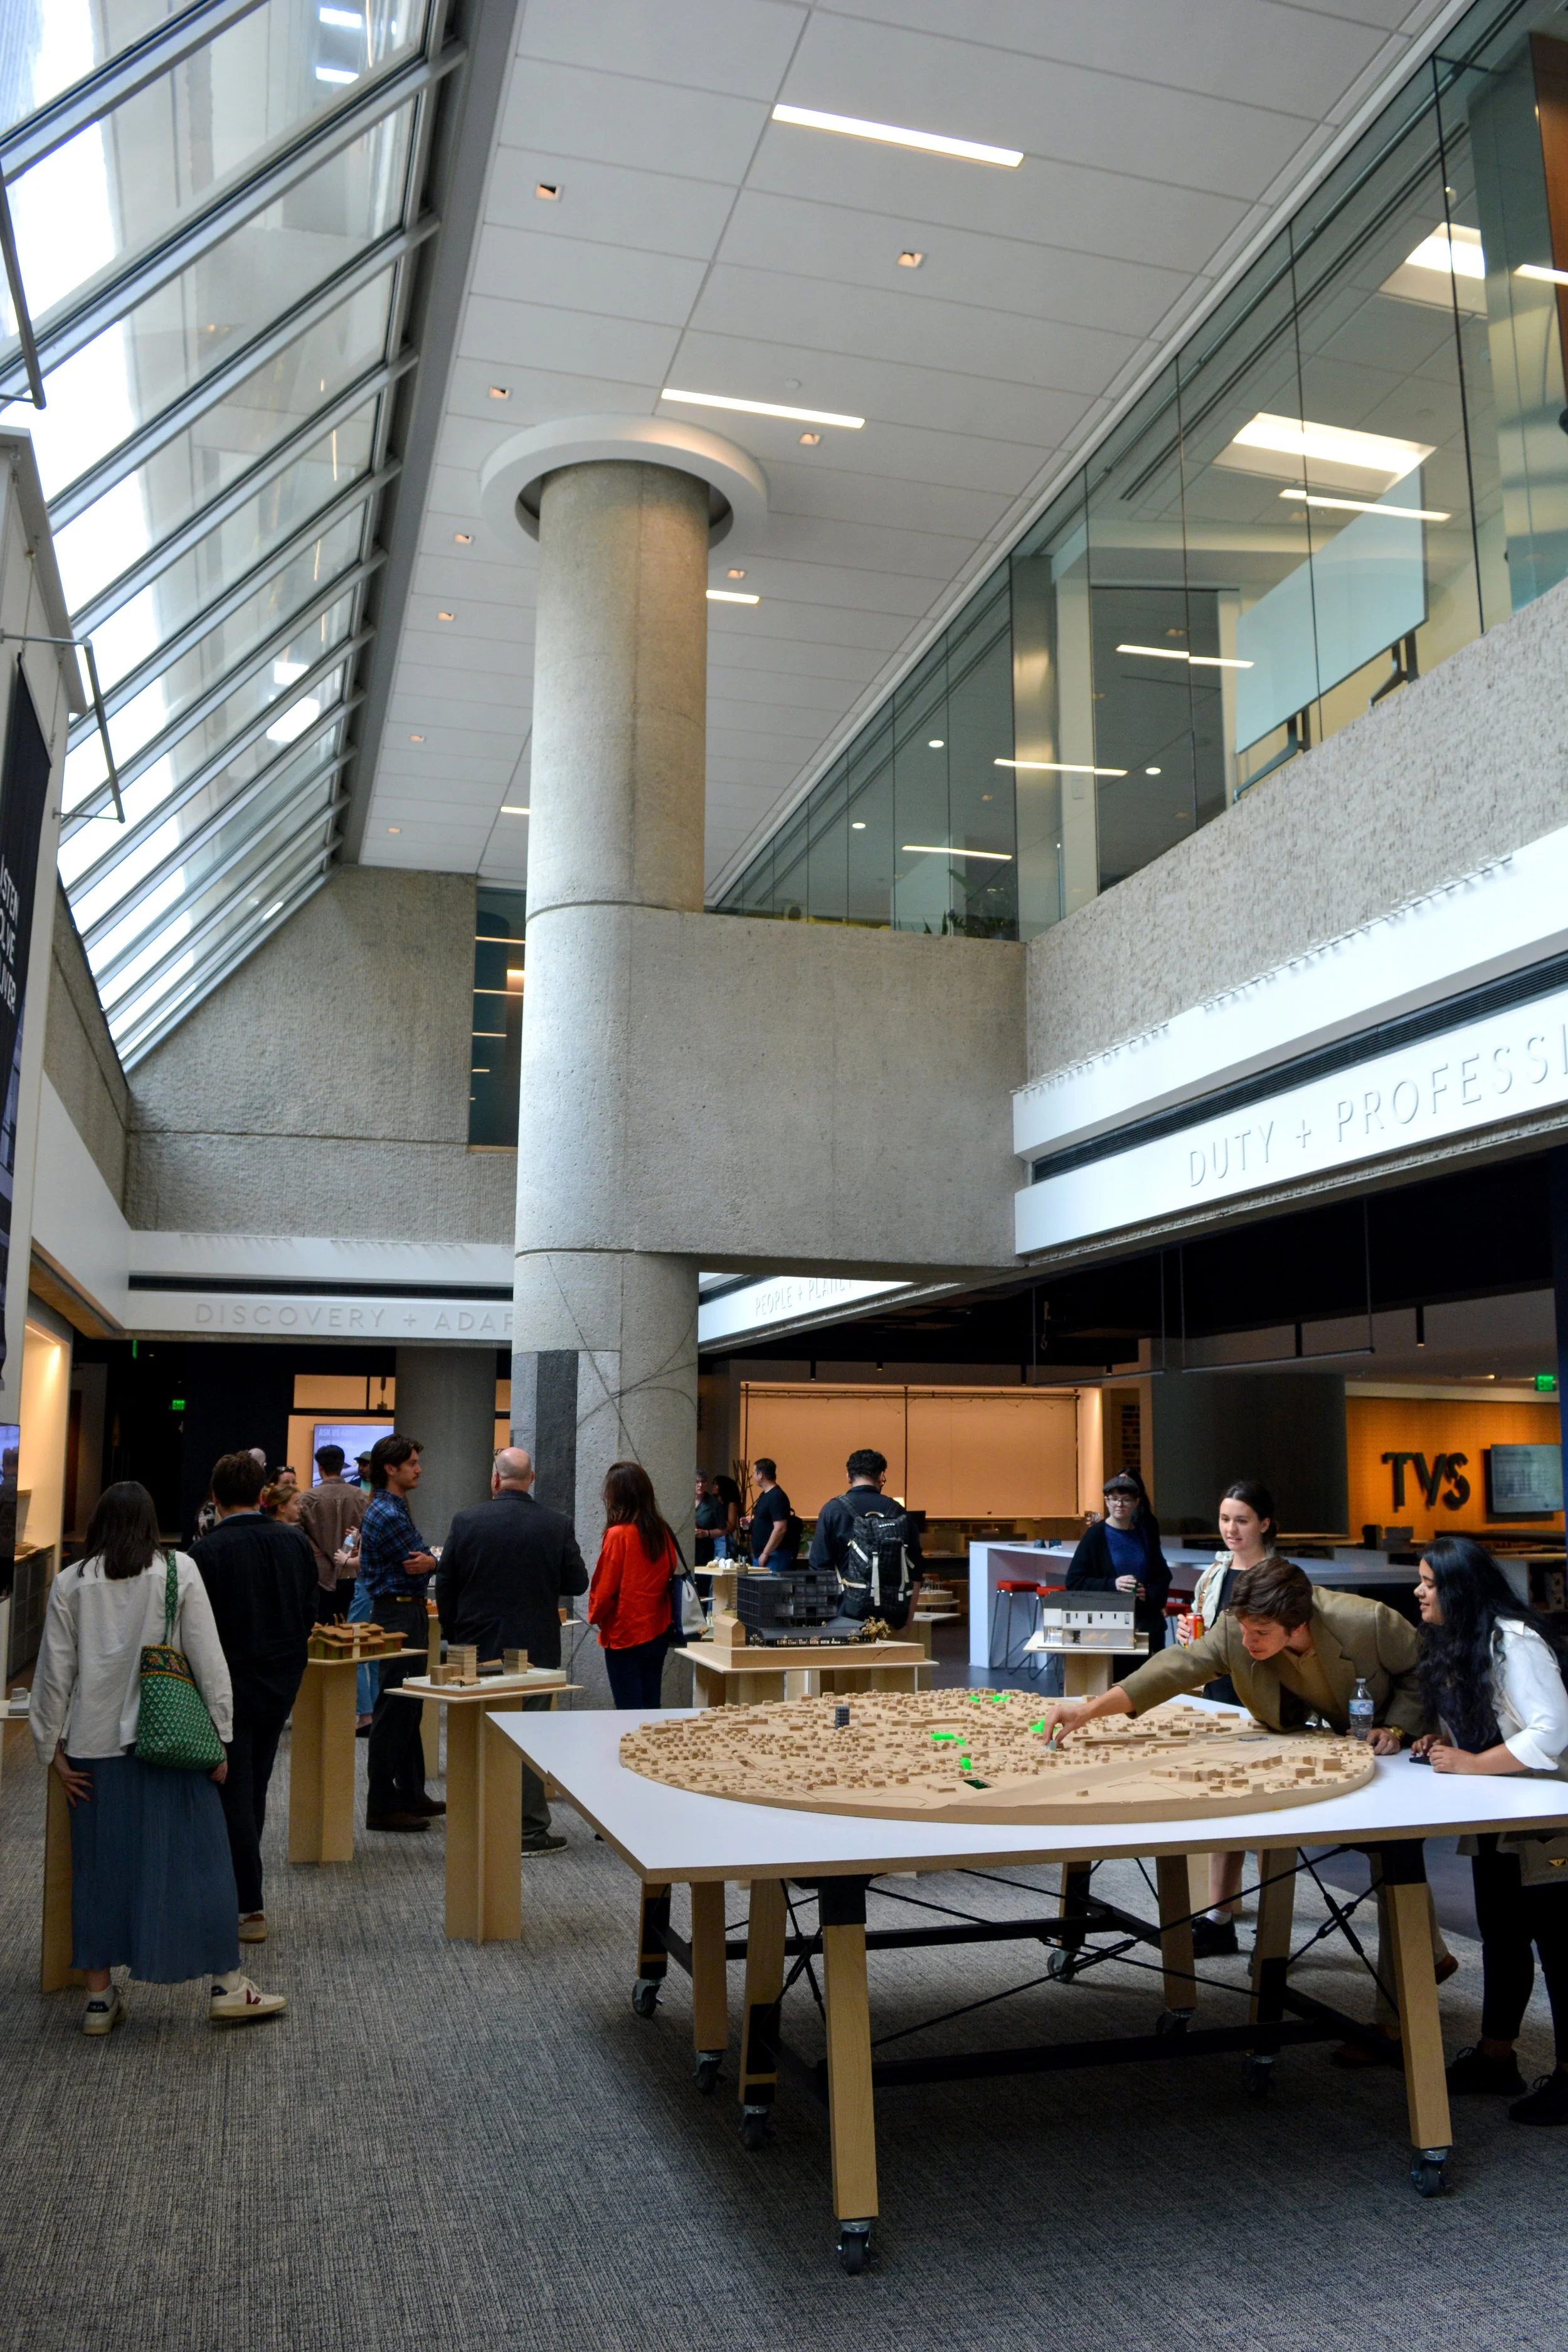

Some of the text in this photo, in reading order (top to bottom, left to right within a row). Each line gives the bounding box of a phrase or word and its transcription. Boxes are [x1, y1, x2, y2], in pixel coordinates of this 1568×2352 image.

[1190, 1022, 1568, 1187] DUTY + PROFESSI
[195, 1303, 384, 1328] DISCOVERY
[403, 1313, 416, 1327] +
[755, 1285, 793, 1317] PEOPLE
[1383, 1452, 1471, 1510] TVS
